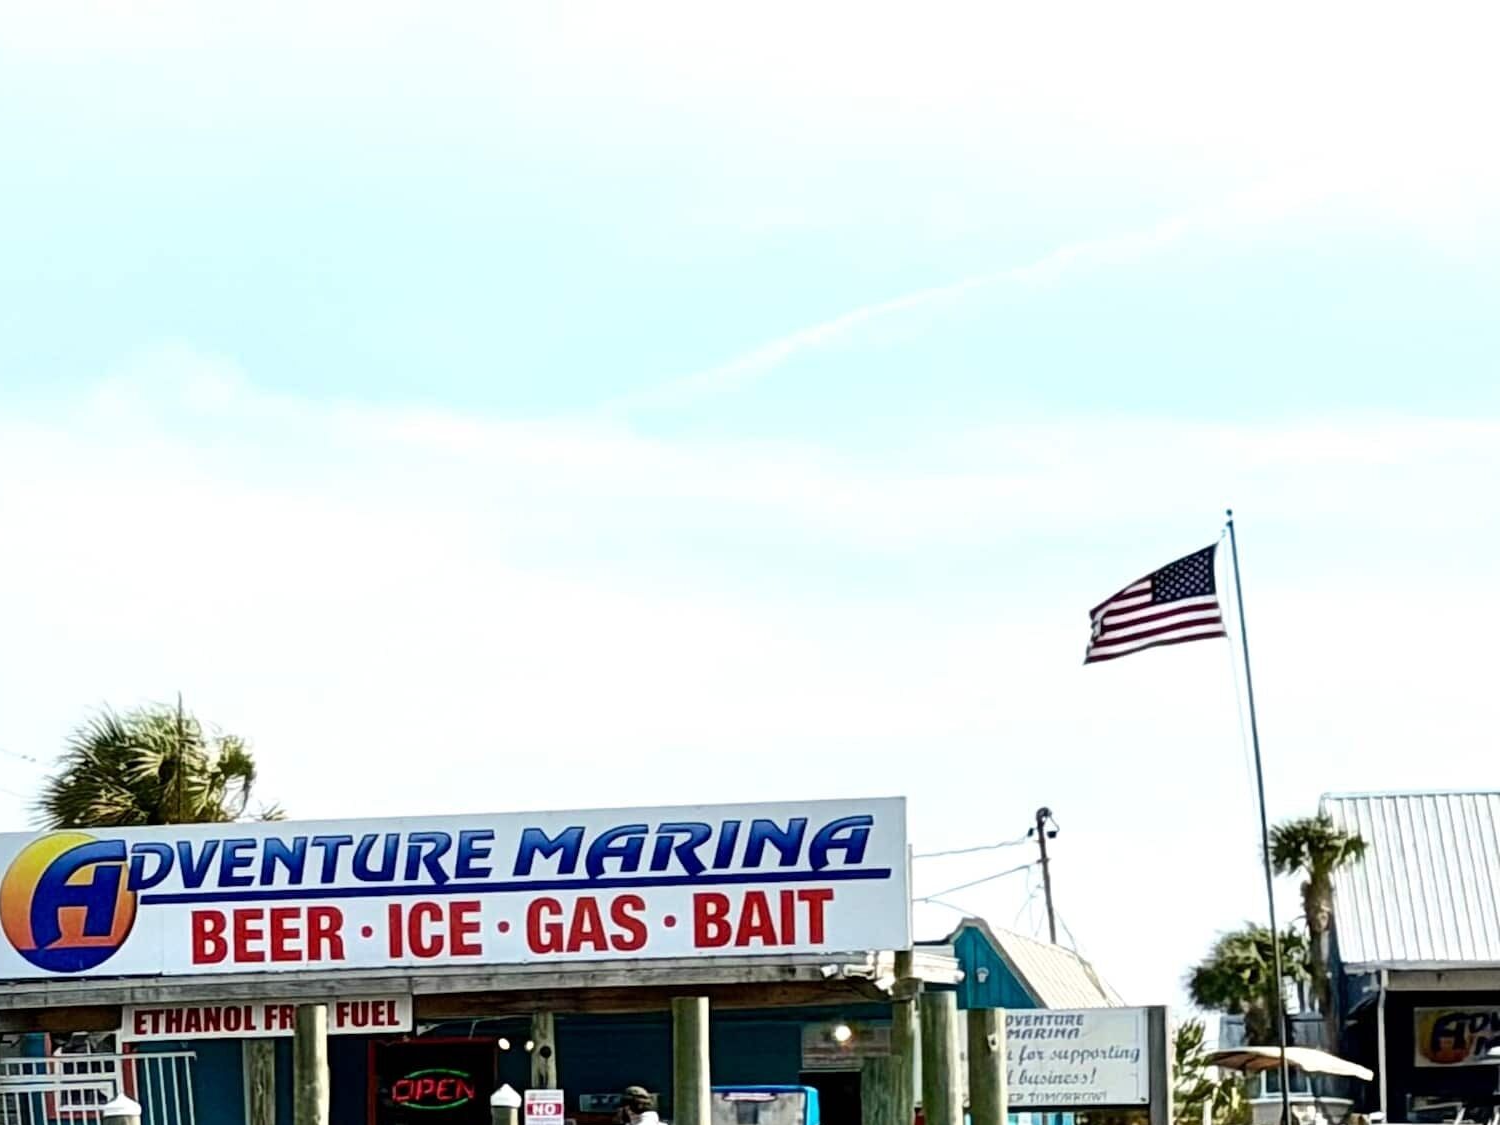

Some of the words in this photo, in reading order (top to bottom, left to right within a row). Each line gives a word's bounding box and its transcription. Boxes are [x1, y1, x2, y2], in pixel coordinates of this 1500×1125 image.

[513, 815, 874, 878] MARINA
[191, 905, 346, 965] BEER
[388, 900, 482, 959] ICE
[525, 894, 648, 955] GAS
[693, 888, 834, 949] BAIT
[133, 1005, 257, 1036] ETHANOL
[264, 1003, 295, 1031] FR
[336, 1000, 400, 1028] FUEL
[1005, 1014, 1084, 1027] DVENTURE
[1018, 1045, 1046, 1065] for
[1050, 1045, 1141, 1064] supporting
[1018, 1067, 1097, 1086] business!
[391, 1078, 476, 1101] OPEN
[531, 1102, 557, 1116] NO
